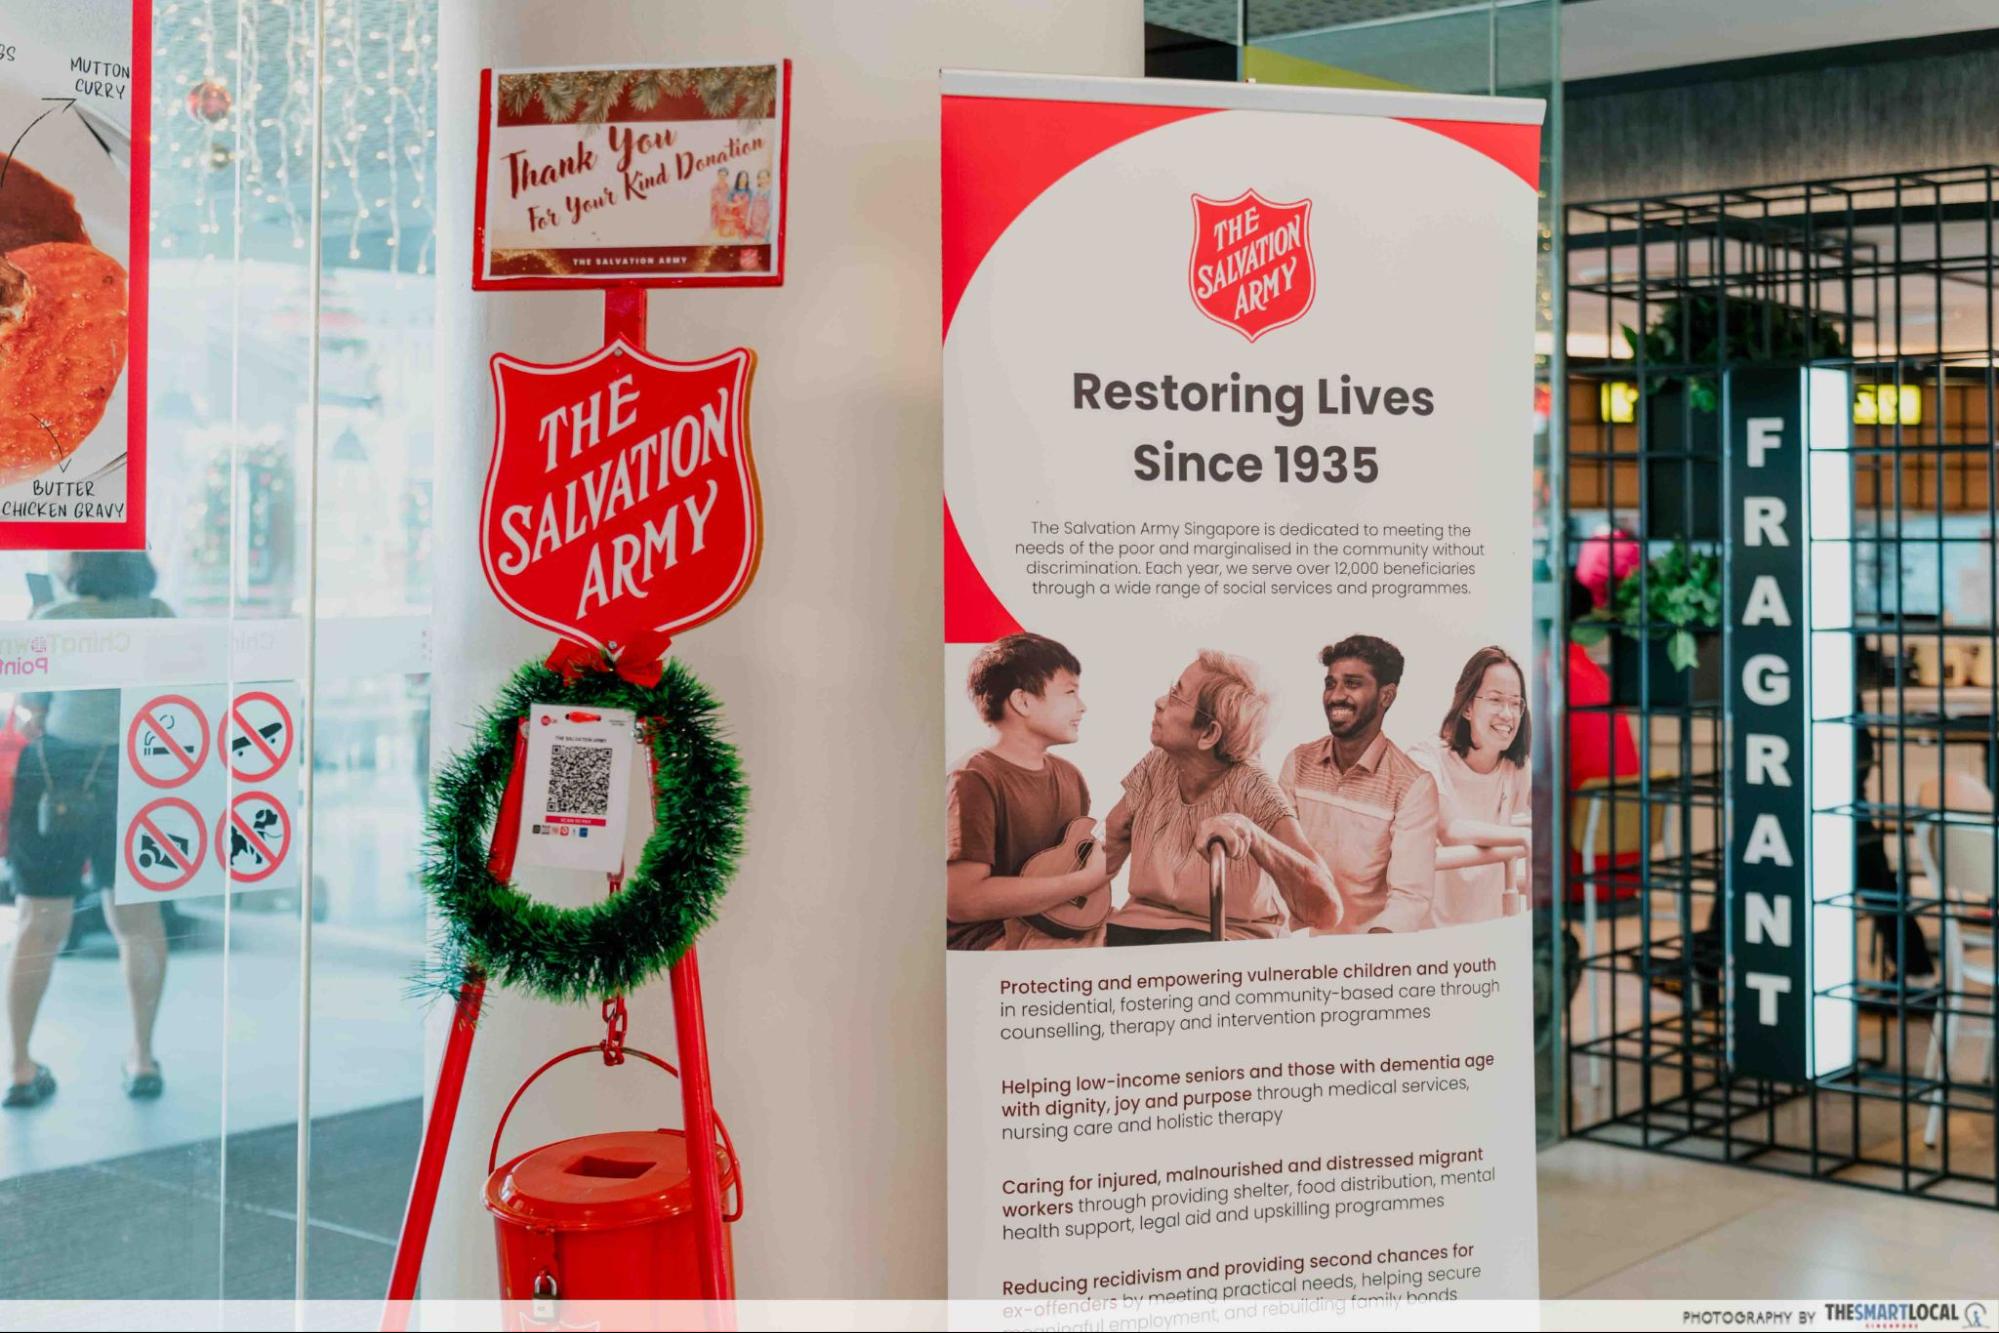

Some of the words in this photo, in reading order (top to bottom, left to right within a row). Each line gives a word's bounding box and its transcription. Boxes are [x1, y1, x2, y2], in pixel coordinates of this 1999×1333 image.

[70, 56, 130, 78] MUTTON
[75, 78, 125, 100] CURRY
[500, 140, 598, 199] Thank
[608, 126, 678, 172] You
[528, 204, 560, 232] For
[566, 187, 618, 224] Your
[624, 168, 670, 201] Kind
[676, 136, 765, 180] Donation
[1214, 206, 1260, 252] THE
[573, 258, 592, 266] THE
[596, 257, 654, 266] SALVATION
[659, 256, 688, 265] ARMY
[1197, 214, 1301, 299] SALVATION
[1234, 256, 1296, 320] ARMY
[1073, 372, 1304, 427] Restoring
[1318, 374, 1434, 416] Lives
[538, 373, 640, 474] THE
[498, 386, 728, 576] SALVATION
[1134, 440, 1263, 482] Since
[1274, 444, 1378, 484] 1935
[2, 501, 67, 518] CHICKEN
[74, 502, 124, 518] GRAVY
[33, 480, 95, 496] BUTTER
[576, 480, 718, 620] ARMY
[1016, 541, 1064, 554] needs
[1070, 541, 1084, 554] of
[1089, 542, 1113, 554] the
[1119, 544, 1152, 558] poor
[1160, 542, 1188, 555] and
[1194, 542, 1290, 558] marginalised
[1296, 542, 1308, 555] in
[1314, 542, 1338, 555] the
[1343, 543, 1428, 558] community
[1432, 543, 1484, 556] without
[1032, 521, 1058, 534] The
[1064, 521, 1135, 535] Salvation
[1141, 522, 1179, 538] Army
[1184, 522, 1260, 539] Singapore
[1264, 522, 1274, 536] is
[1280, 522, 1358, 536] dedicated
[1364, 524, 1378, 536] to
[1384, 523, 1443, 540] meeting
[1448, 524, 1470, 536] the
[1027, 561, 1140, 574] discrimination.
[1146, 561, 1182, 574] Each
[1187, 565, 1222, 577] year,
[1226, 566, 1247, 574] we
[1252, 565, 1292, 574] serve
[1296, 566, 1330, 574] over
[1336, 562, 1378, 576] 12,000
[1384, 562, 1475, 574] beneficiaries
[1032, 580, 1094, 598] through
[1100, 584, 1110, 594] a
[1115, 581, 1150, 594] wide
[1156, 584, 1200, 598] range
[1204, 581, 1218, 594] of
[1224, 581, 1266, 594] social
[1271, 581, 1332, 594] services
[1337, 582, 1367, 594] and
[1372, 584, 1470, 598] programmes.
[1742, 417, 1794, 1027] FRAGRANT
[1000, 978, 1093, 996] Protecting
[1098, 975, 1132, 991] and
[1137, 969, 1242, 991] empowering
[1248, 965, 1338, 982] vulnerable
[1343, 963, 1411, 978] children
[1416, 960, 1448, 975] and
[1453, 958, 1496, 978] youth
[1001, 1002, 1015, 1017] in
[1022, 998, 1115, 1016] residential,
[1120, 994, 1193, 1012] fostering
[1198, 991, 1230, 1007] and
[1236, 984, 1393, 1005] community-based
[1398, 984, 1435, 998] care
[1440, 980, 1500, 998] through
[1000, 1022, 1104, 1040] counselling,
[1110, 1018, 1175, 1036] therapy
[1180, 1014, 1212, 1030] and
[1217, 1009, 1315, 1028] intervention
[1321, 1006, 1430, 1026] programmes
[1002, 1078, 1071, 1097] Helping
[1076, 1072, 1180, 1091] low-income
[1186, 1066, 1244, 1082] seniors
[1250, 1064, 1282, 1079] and
[1288, 1062, 1334, 1076] those
[1340, 1059, 1374, 1074] with
[1380, 1054, 1460, 1072] dementia
[1465, 1054, 1494, 1071] age
[1002, 1101, 1040, 1117] with
[1046, 1099, 1110, 1119] dignity,
[1115, 1096, 1140, 1115] joy
[1146, 1093, 1178, 1109] and
[1184, 1089, 1252, 1110] purpose
[1257, 1083, 1322, 1102] through
[1328, 1080, 1396, 1097] medical
[1402, 1077, 1469, 1093] services,
[1002, 1124, 1068, 1142] nursing
[1074, 1121, 1112, 1137] care
[1118, 1117, 1150, 1133] and
[1157, 1113, 1213, 1130] holistic
[1219, 1109, 1283, 1126] therapy
[1002, 1178, 1064, 1196] Caring
[1070, 1176, 1092, 1190] for
[1098, 1171, 1160, 1192] injured,
[1166, 1160, 1282, 1183] malnourished
[1288, 1158, 1321, 1173] and
[1327, 1152, 1414, 1171] distressed
[1419, 1148, 1483, 1168] migrant
[1002, 1200, 1073, 1217] workers
[1079, 1194, 1146, 1213] through
[1152, 1188, 1228, 1210] providing
[1234, 1182, 1292, 1199] shelter,
[1298, 1178, 1335, 1194] food
[1341, 1172, 1436, 1192] distribution,
[1441, 1168, 1495, 1186] mental
[1003, 1224, 1059, 1240] health
[1065, 1218, 1134, 1239] support,
[1140, 1212, 1180, 1232] legal
[1186, 1210, 1210, 1225] aid
[1216, 1206, 1248, 1222] and
[1254, 1202, 1329, 1222] upskilling
[1336, 1195, 1444, 1218] programmes
[1003, 1276, 1087, 1295] Reducing
[1094, 1268, 1181, 1289] recidivism
[1187, 1262, 1218, 1279] and
[1225, 1256, 1304, 1279] providing
[1310, 1250, 1372, 1268] second
[1377, 1246, 1448, 1263] chances
[1453, 1243, 1474, 1257] for
[1003, 1297, 1117, 1318] ex-offenders
[1123, 1294, 1143, 1312] by
[1149, 1286, 1217, 1303] meeting
[1223, 1278, 1296, 1301] practical
[1302, 1274, 1357, 1290] needs,
[1362, 1269, 1422, 1289] helping
[1428, 1266, 1481, 1282] secure
[1225, 1303, 1257, 1320] and
[1262, 1297, 1345, 1318] rebuilding
[1351, 1293, 1402, 1310] family
[1406, 1288, 1457, 1305] bonds
